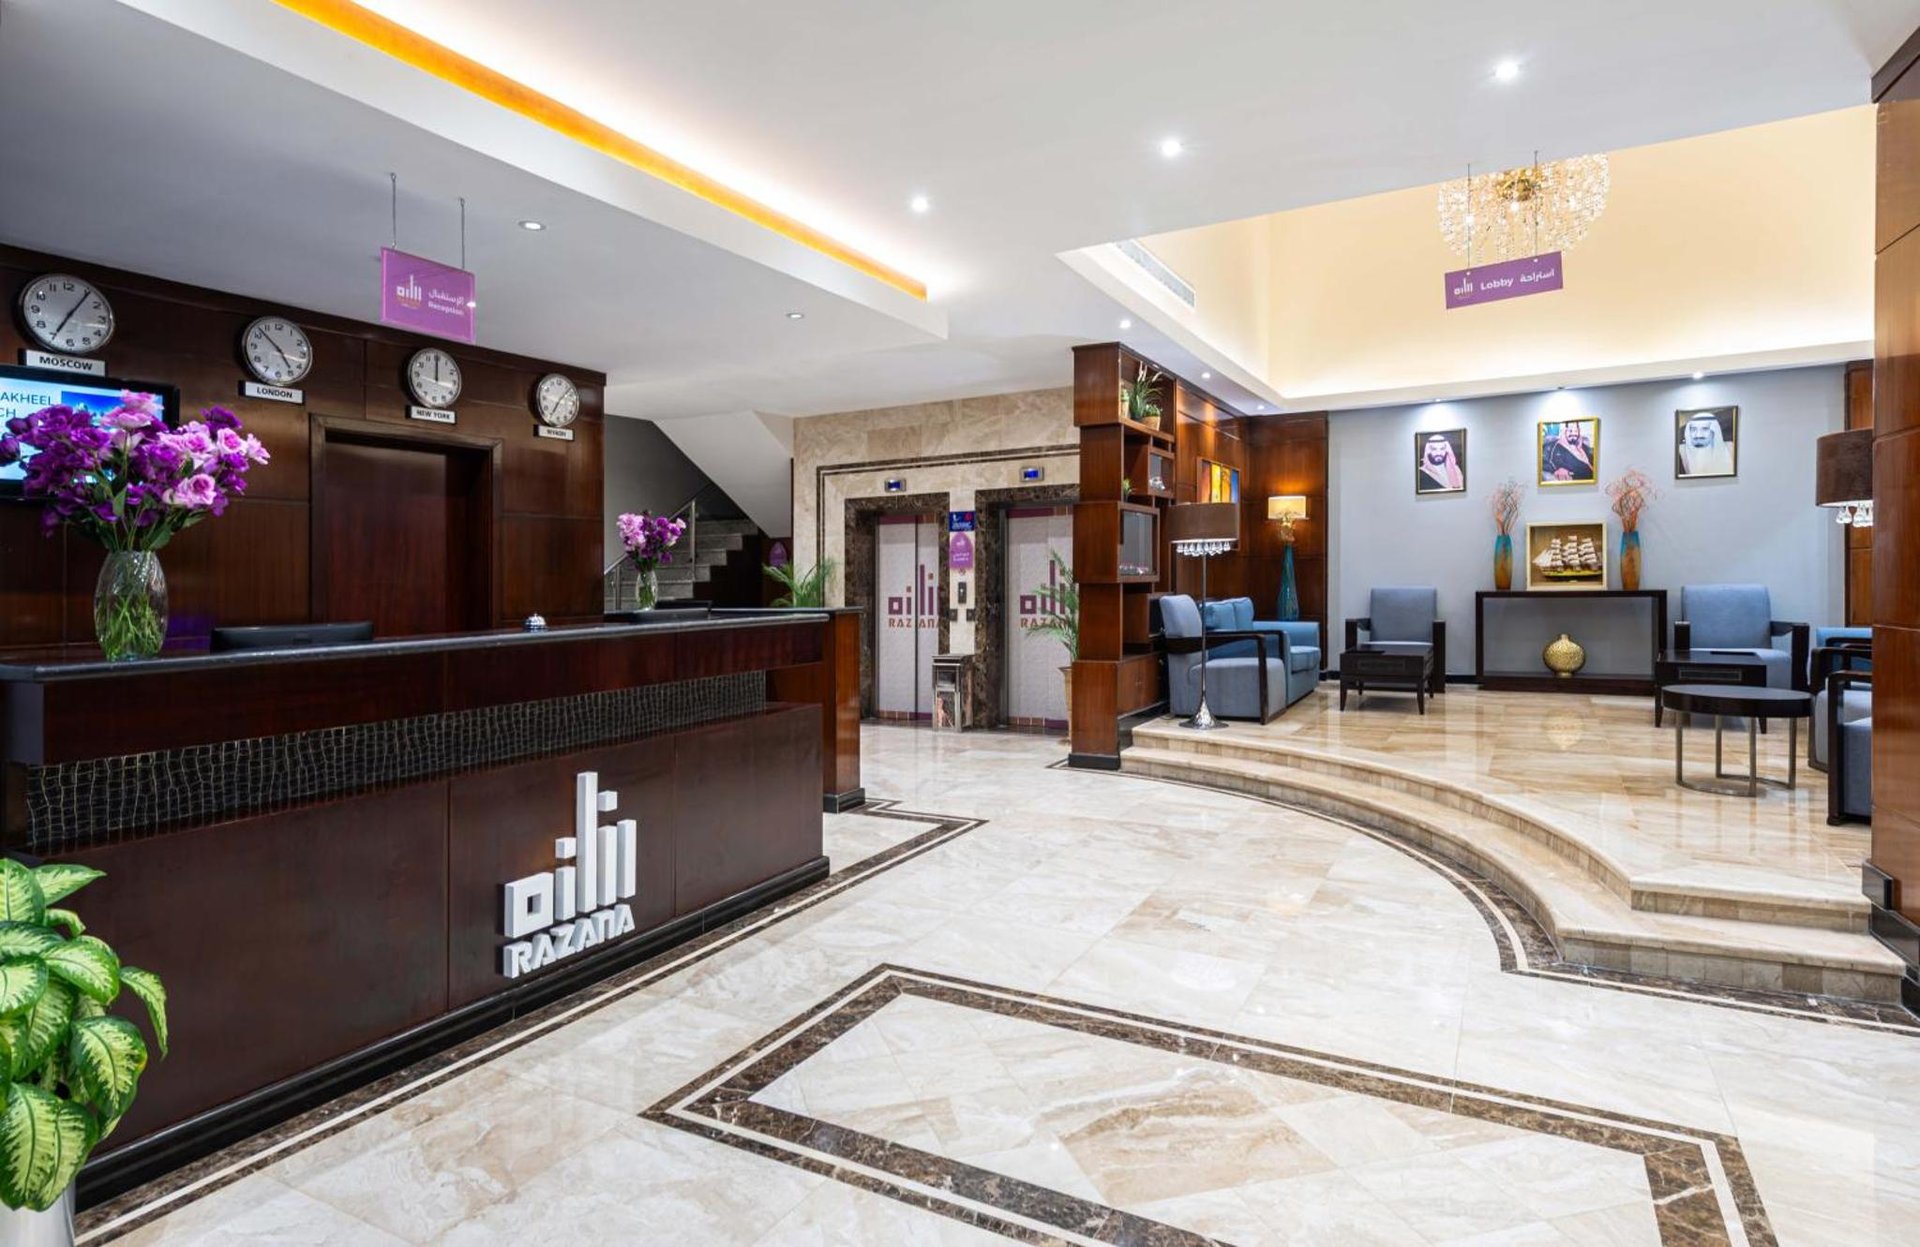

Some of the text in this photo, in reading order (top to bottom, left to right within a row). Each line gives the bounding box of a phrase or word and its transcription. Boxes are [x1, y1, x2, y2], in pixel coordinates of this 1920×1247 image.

[49, 283, 57, 292] 11
[63, 281, 75, 292] 12
[1480, 277, 1515, 291] Lobby
[37, 290, 46, 301] 10
[31, 304, 40, 314] 9
[93, 301, 102, 310] 2
[36, 320, 46, 329] 8
[98, 315, 106, 324] 3
[93, 329, 102, 337] 4
[66, 338, 75, 347] 6
[82, 336, 91, 346] 5
[39, 355, 93, 371] MOSCOW
[256, 386, 293, 399] LONDON
[416, 408, 450, 420] NEW YORK
[503, 904, 636, 979] RAZANA
